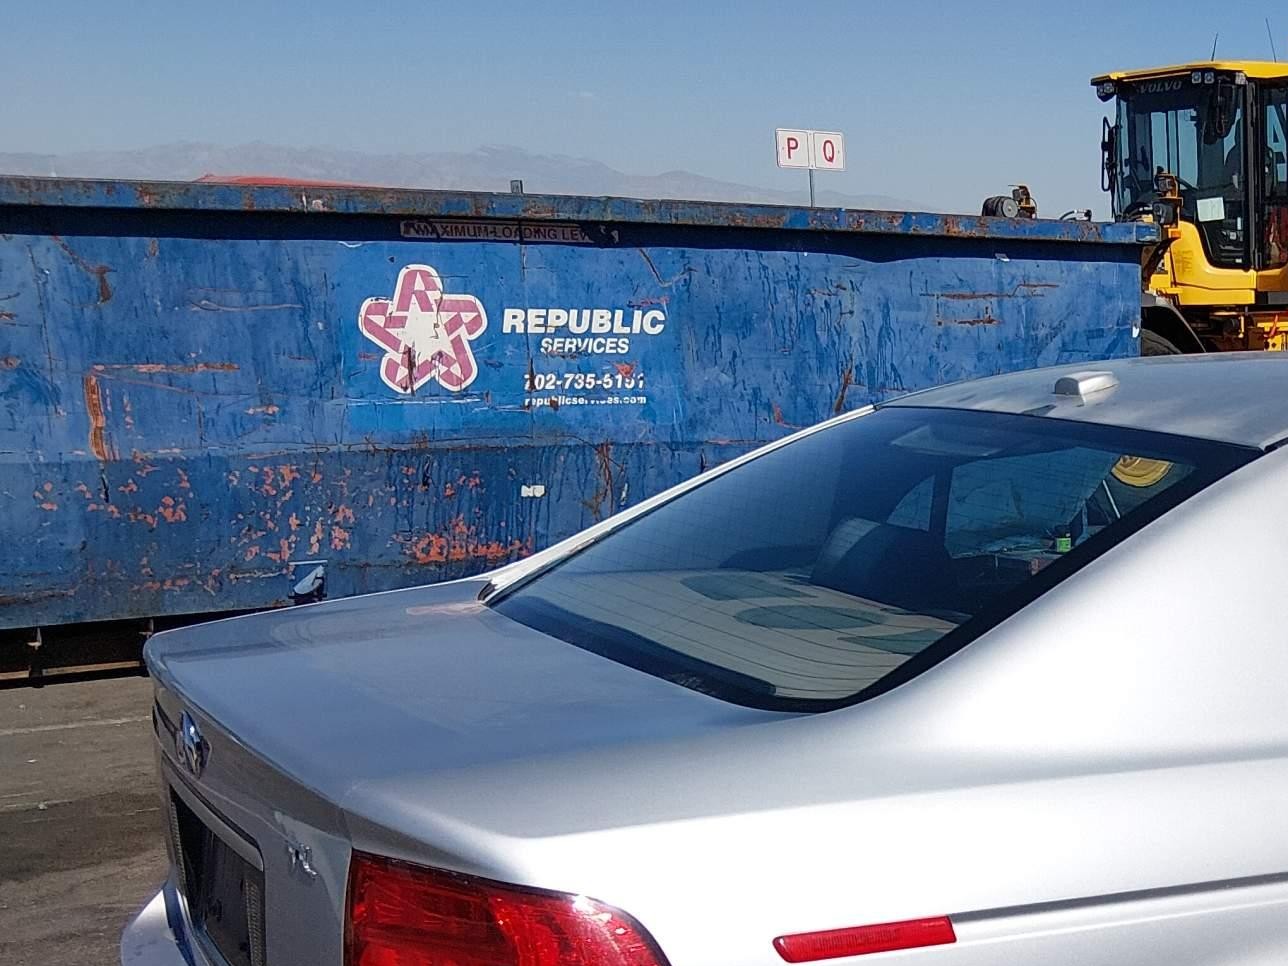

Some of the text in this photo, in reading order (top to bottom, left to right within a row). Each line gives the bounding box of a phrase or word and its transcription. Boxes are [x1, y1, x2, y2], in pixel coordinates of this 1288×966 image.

[1139, 80, 1182, 94] VOLVO
[786, 137, 835, 163] P Q
[502, 308, 666, 335] REPUBLIC
[539, 337, 630, 355] SERVICES
